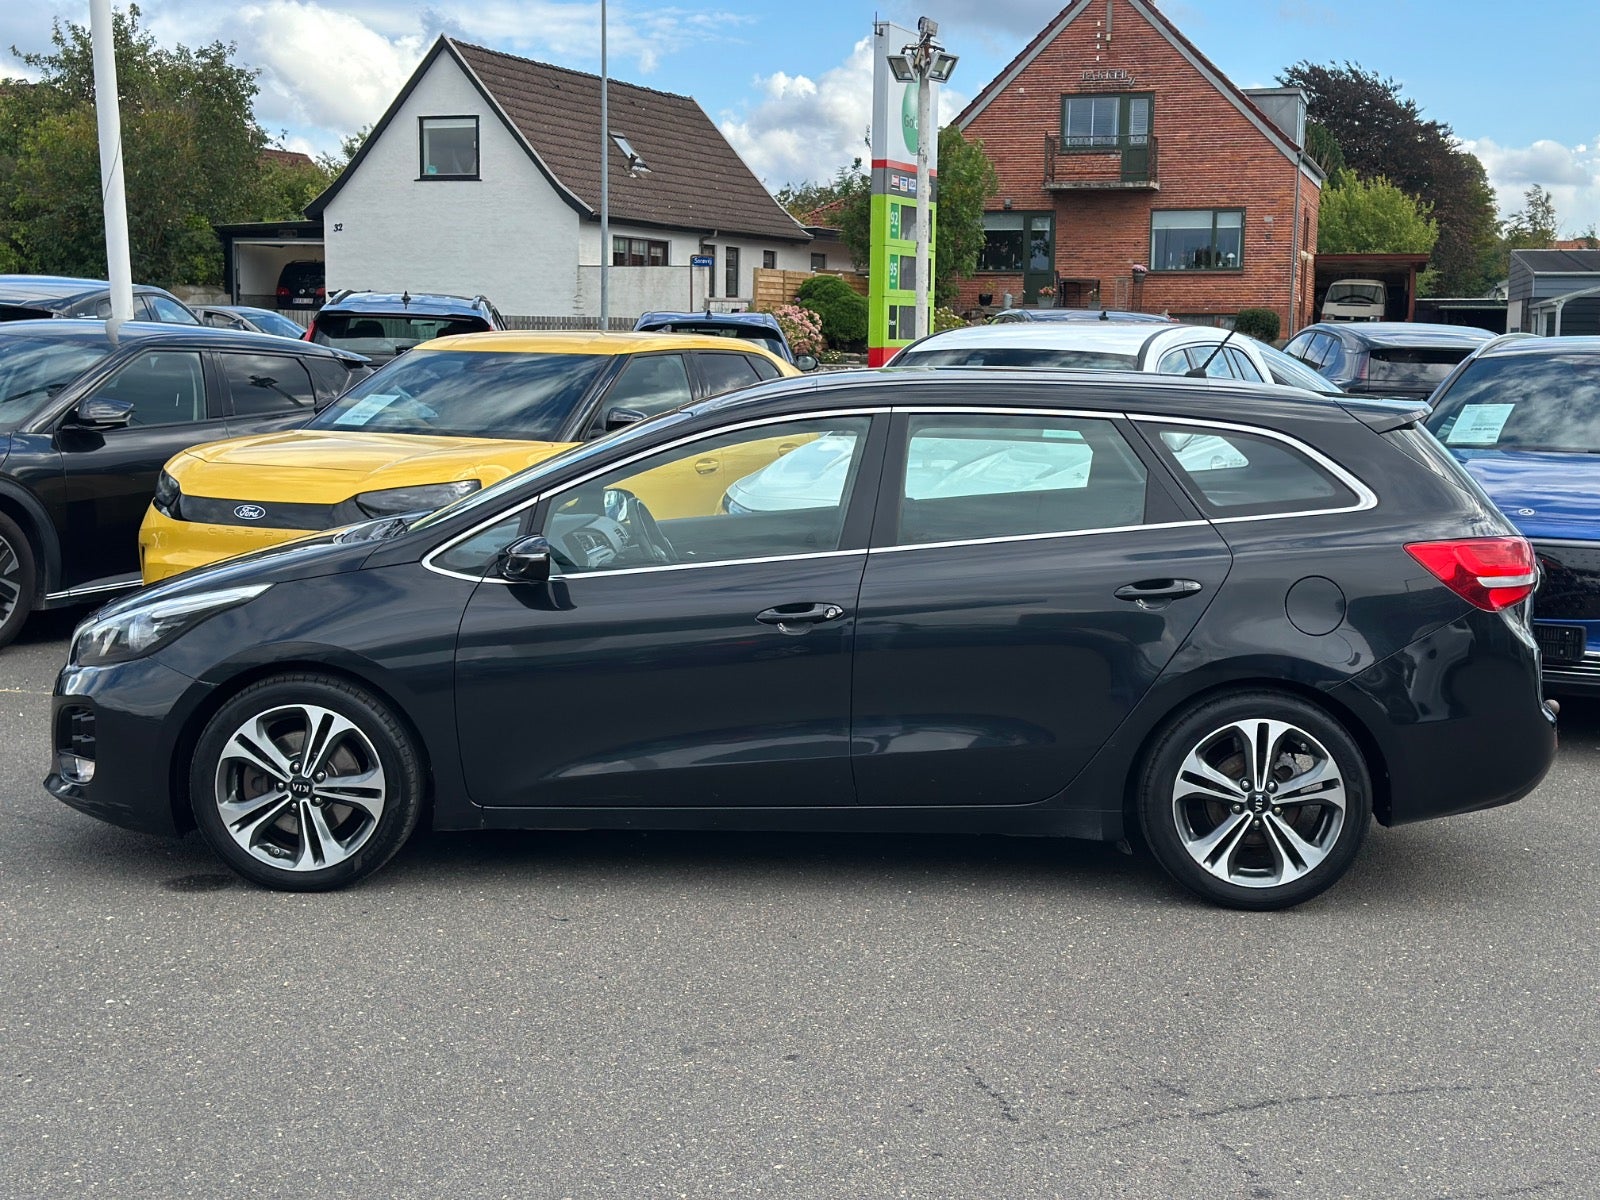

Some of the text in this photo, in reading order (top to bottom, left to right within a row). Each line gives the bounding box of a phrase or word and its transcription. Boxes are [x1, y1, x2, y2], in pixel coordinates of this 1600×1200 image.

[890, 211, 899, 226] 92
[333, 223, 343, 232] 32
[889, 262, 898, 276] 95
[238, 506, 260, 518] Ford
[292, 782, 310, 793] KIA
[1255, 794, 1263, 812] KIA
